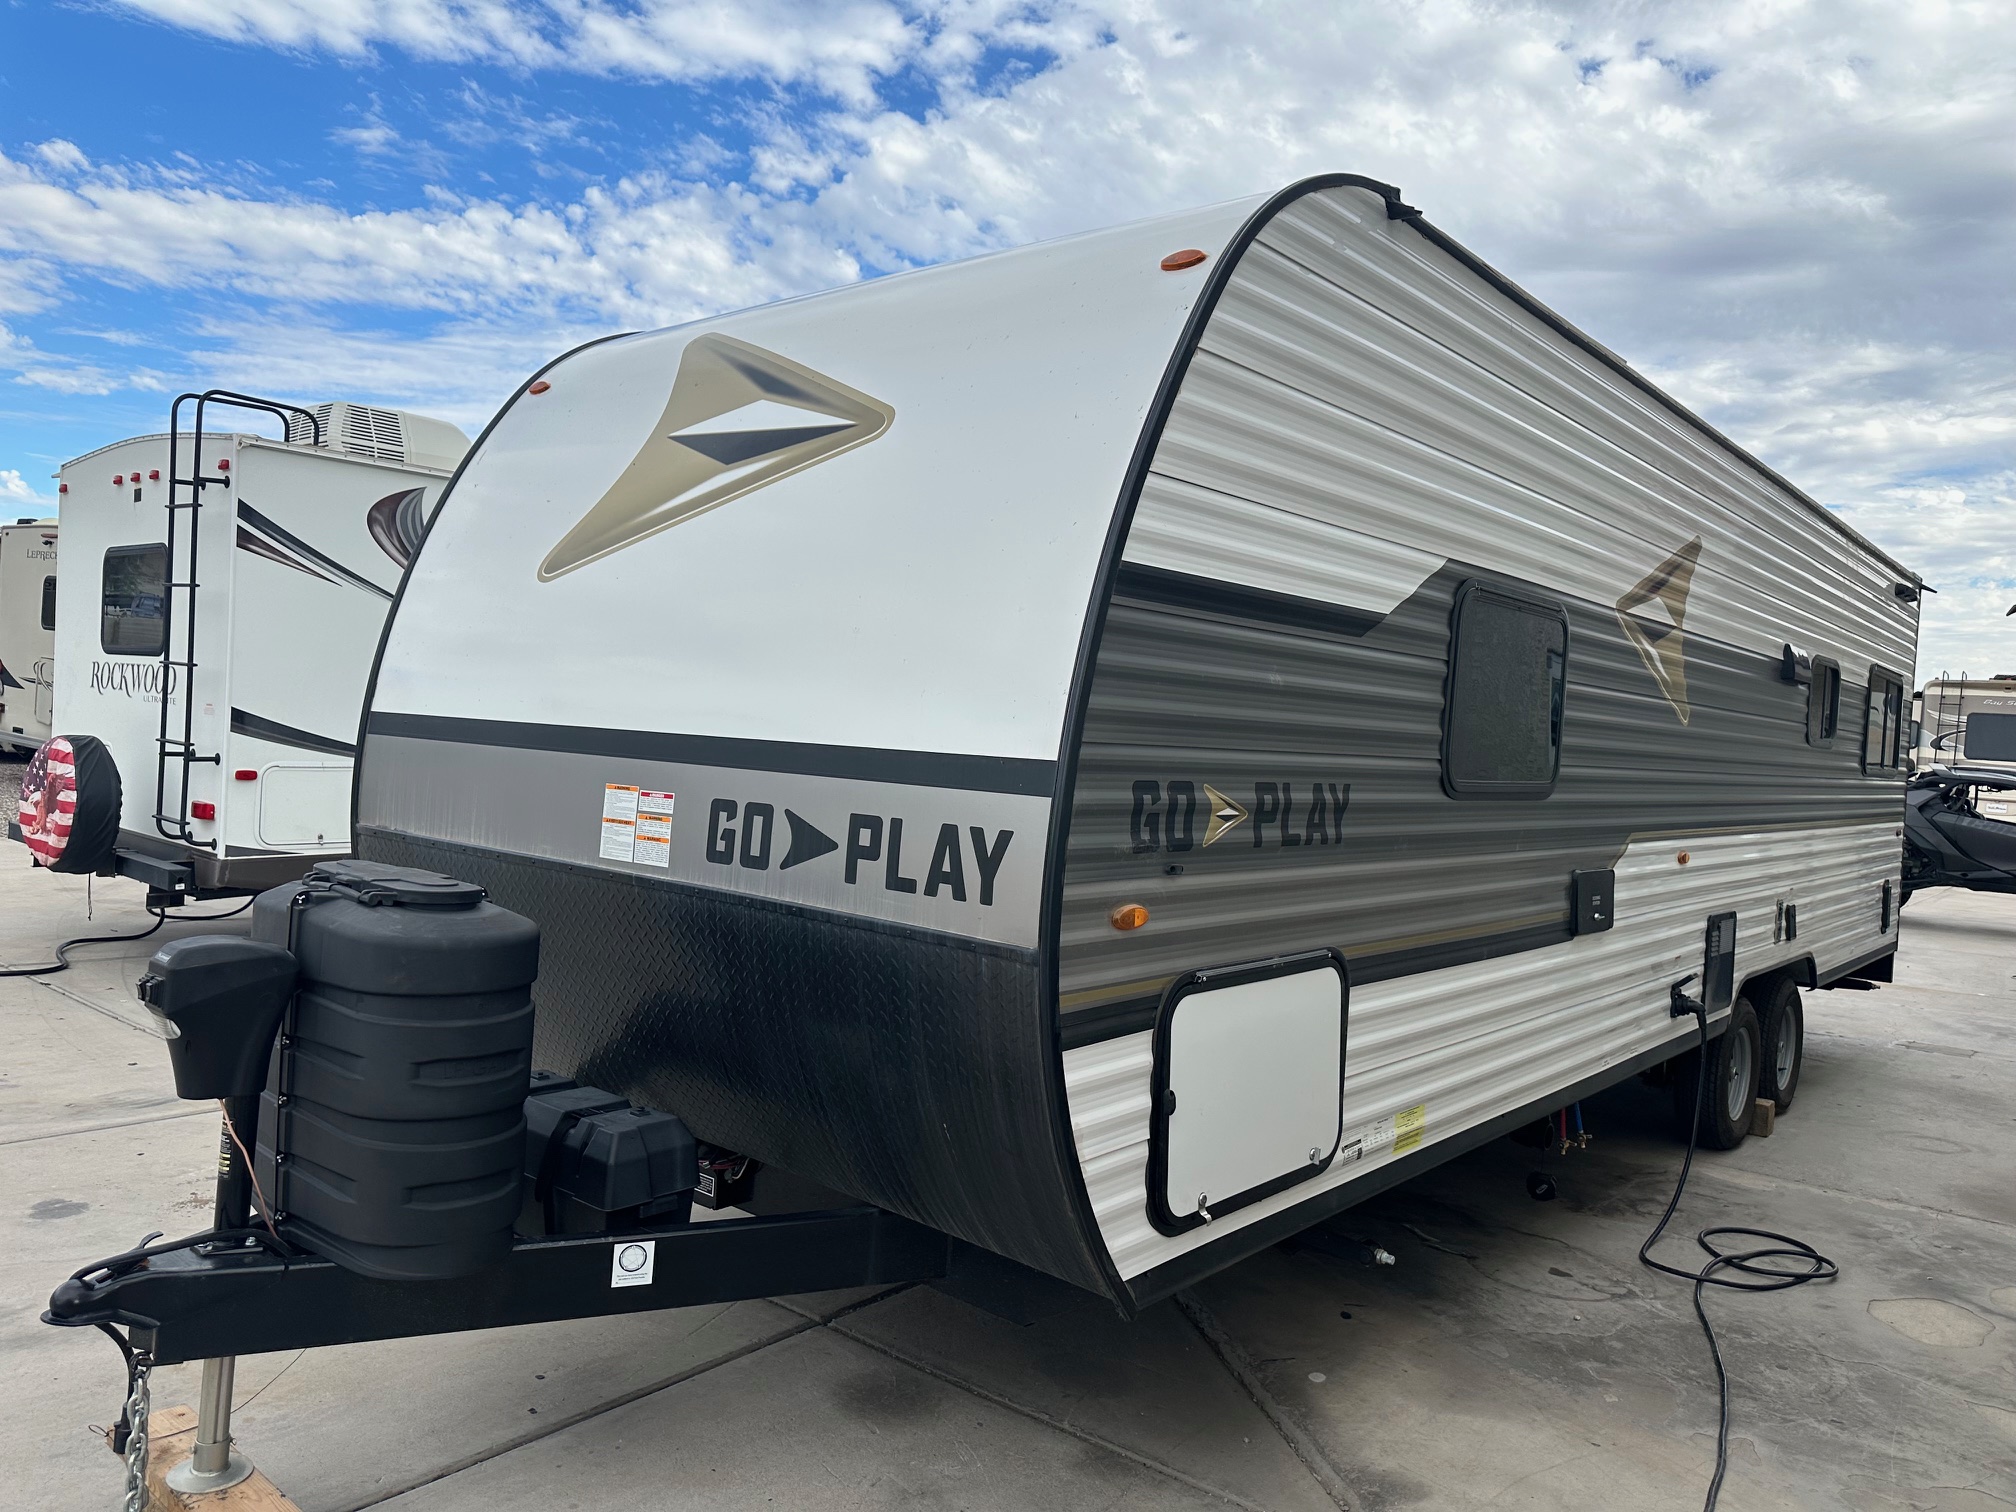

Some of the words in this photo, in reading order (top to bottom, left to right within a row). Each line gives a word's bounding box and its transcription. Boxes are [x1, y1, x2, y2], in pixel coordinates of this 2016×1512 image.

[90, 661, 177, 699] ROCKWOOD
[706, 797, 775, 871] GO
[844, 812, 1015, 906] PLAY
[1130, 779, 1197, 854] GO
[1252, 781, 1352, 848] PLAY
